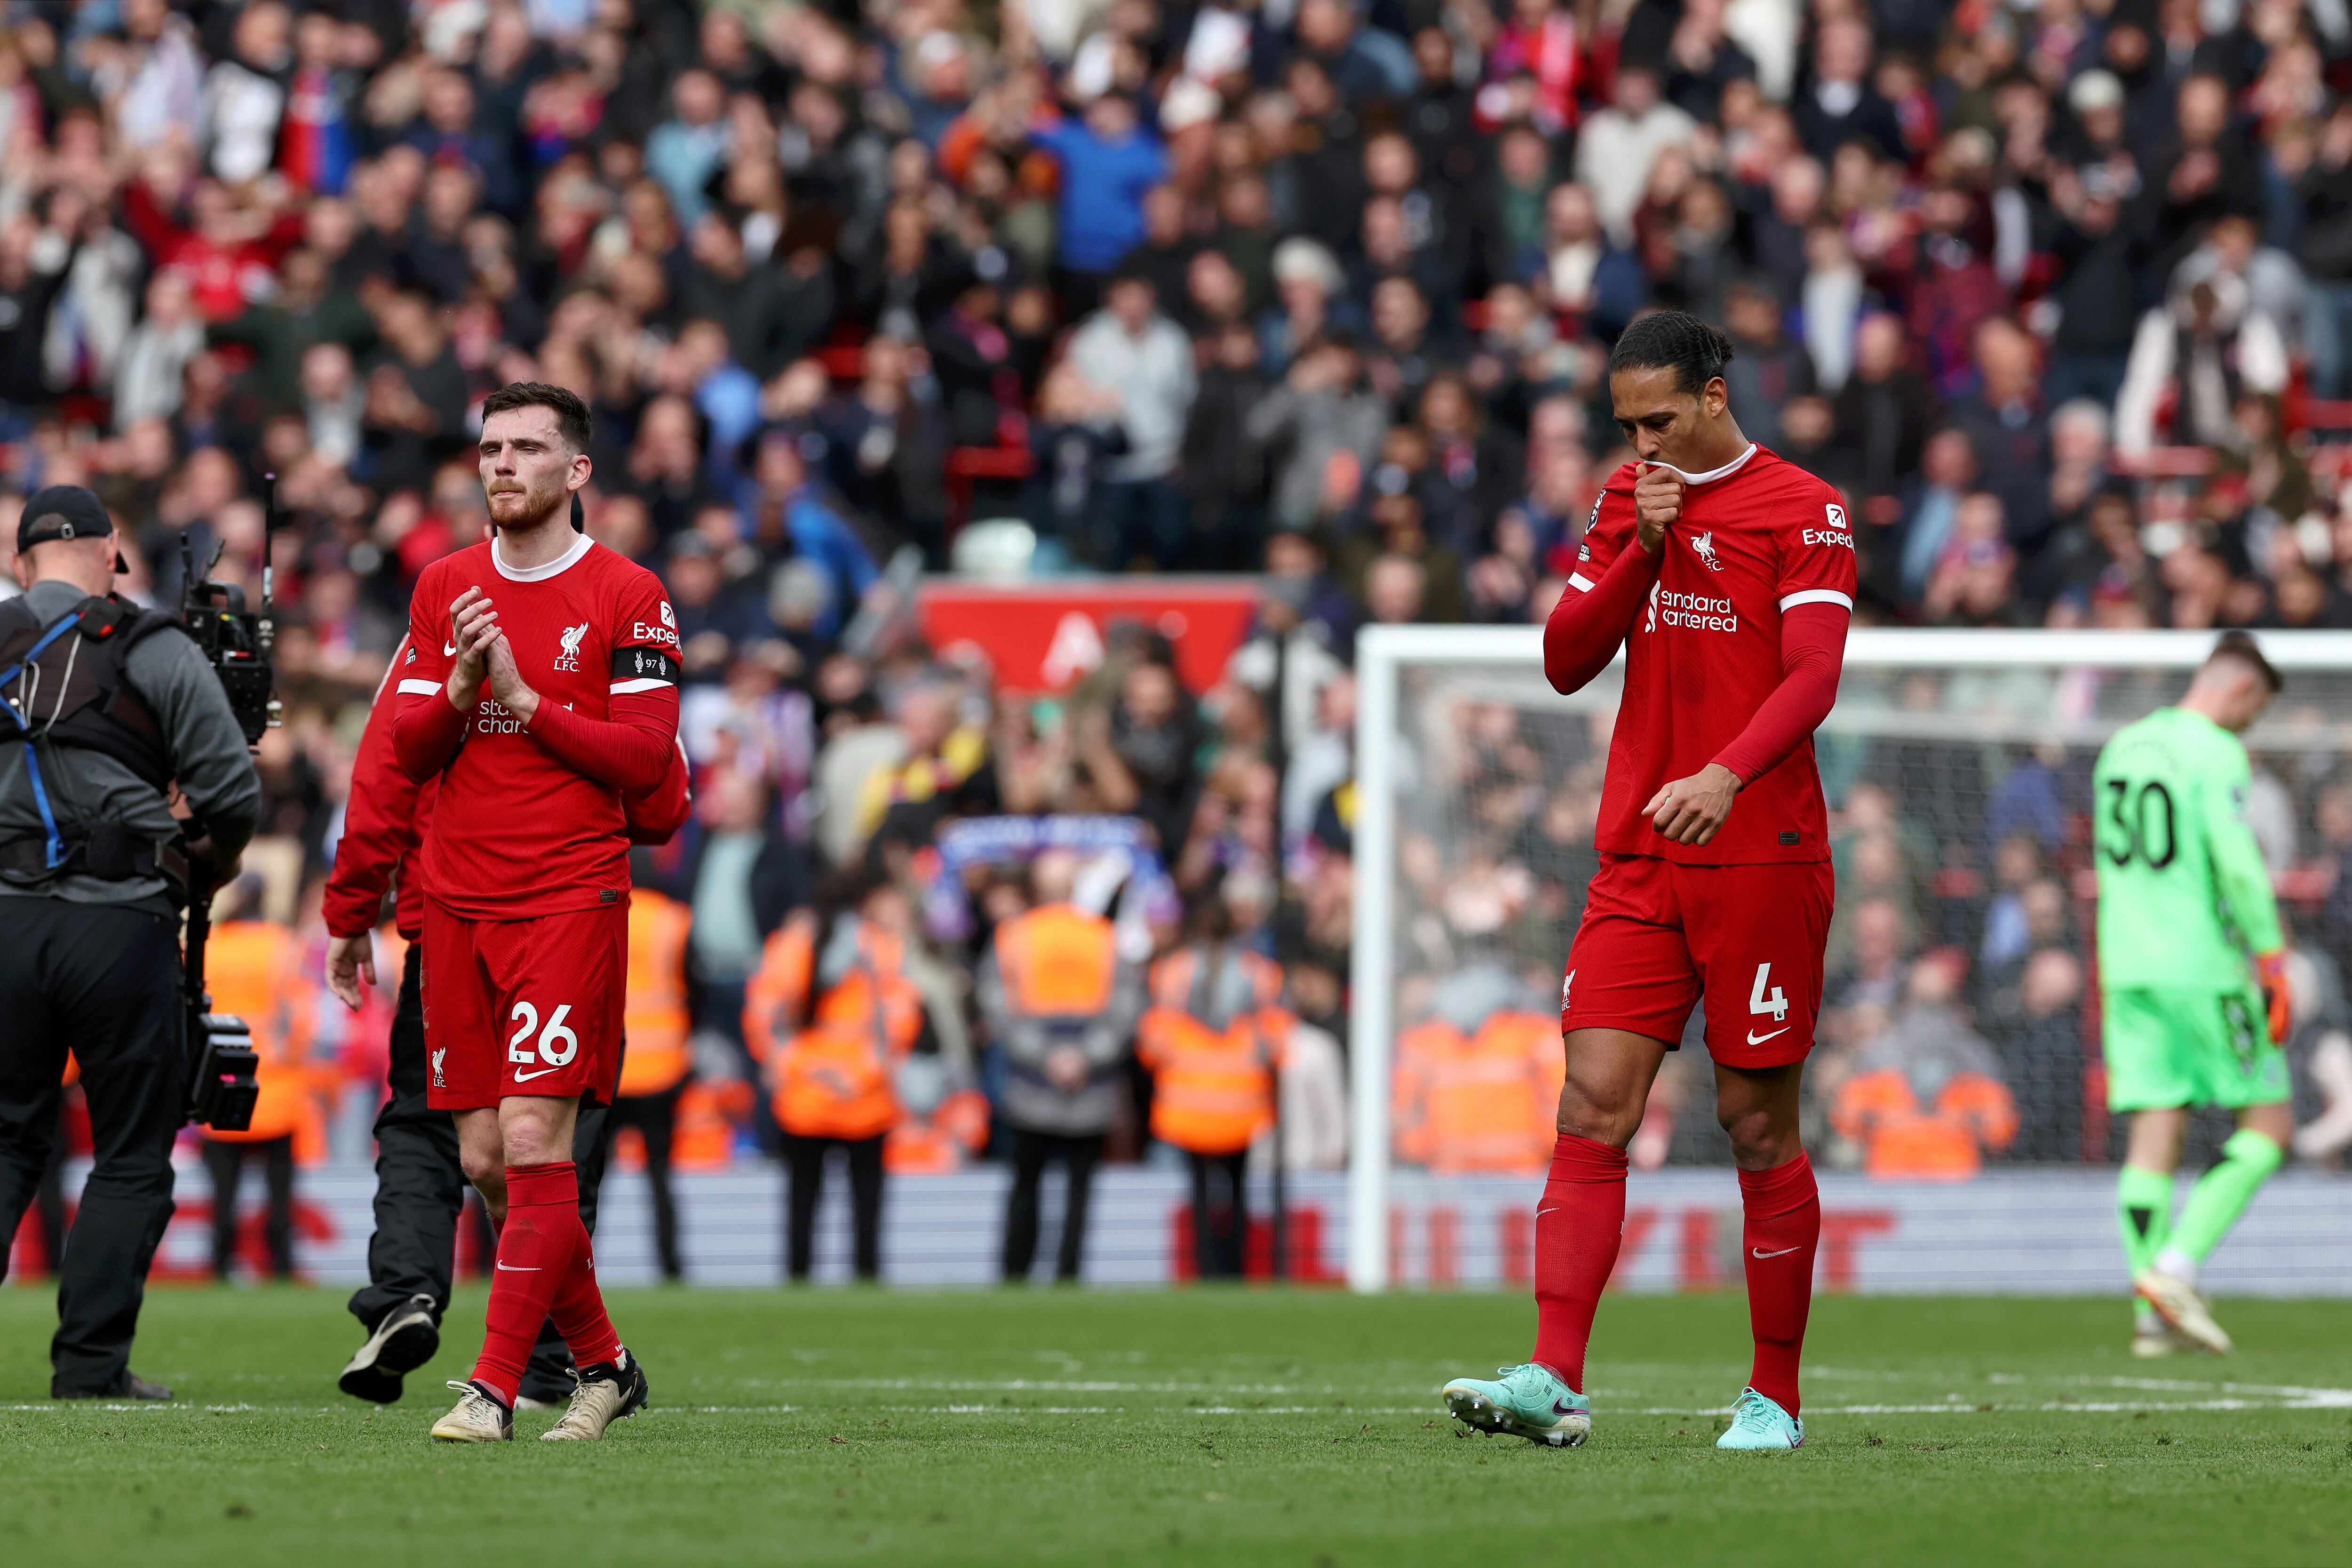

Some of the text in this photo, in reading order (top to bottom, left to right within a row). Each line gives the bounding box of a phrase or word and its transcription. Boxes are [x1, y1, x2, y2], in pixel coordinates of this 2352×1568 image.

[553, 660, 580, 672] L.F.C.
[645, 659, 657, 669] 97
[2102, 778, 2175, 870] 30
[1749, 962, 1788, 1021] 4
[508, 1001, 578, 1067] 26
